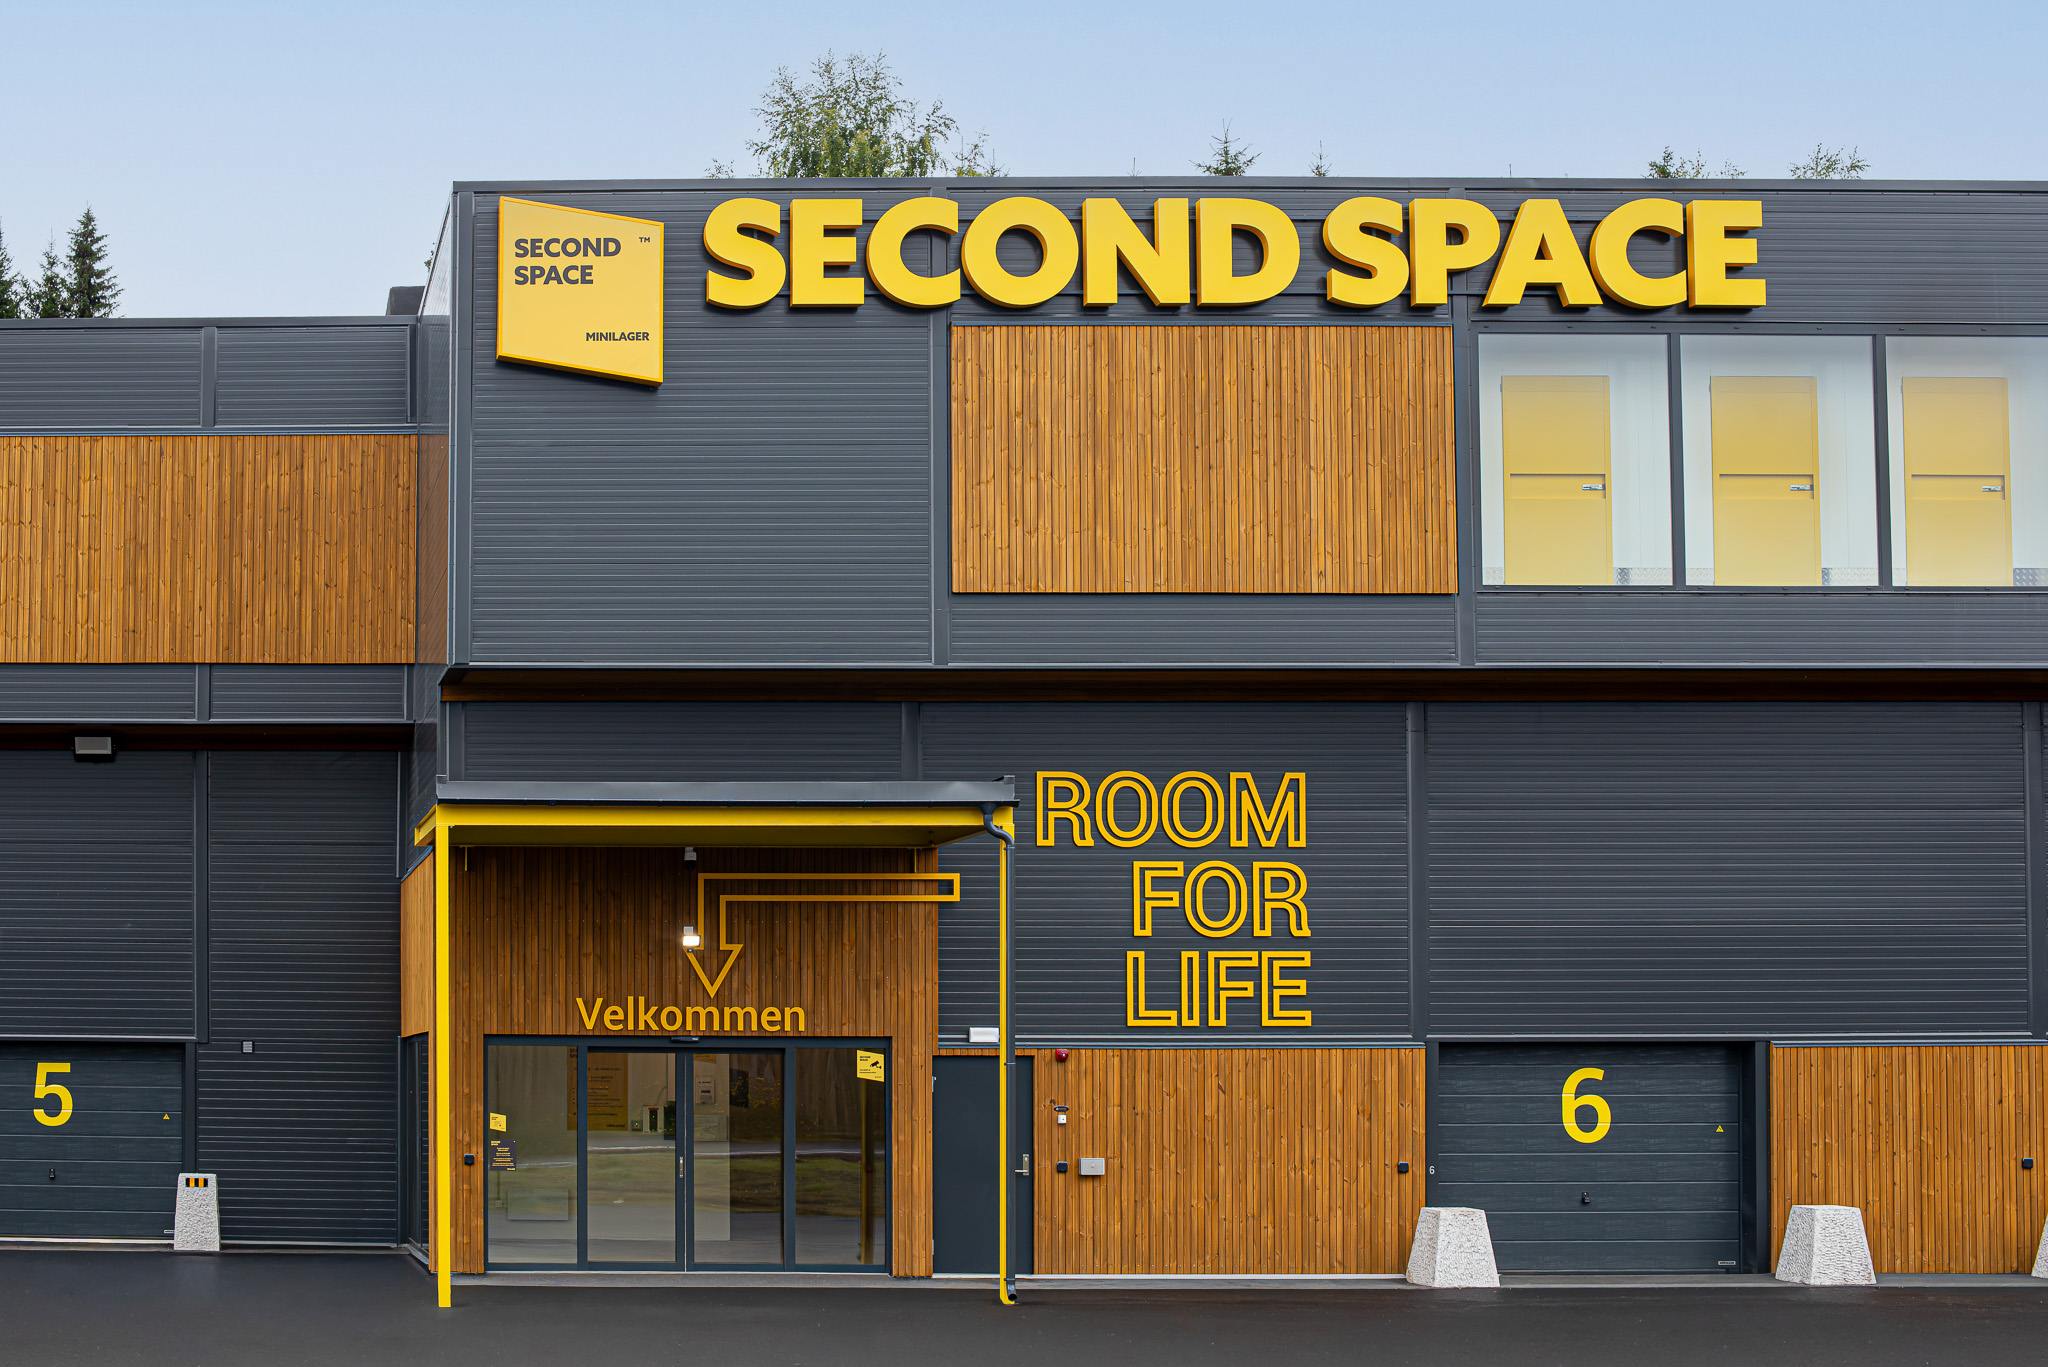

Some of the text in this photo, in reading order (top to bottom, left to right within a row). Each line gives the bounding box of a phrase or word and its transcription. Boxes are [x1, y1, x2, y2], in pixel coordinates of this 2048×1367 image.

[514, 237, 621, 258] SECOND
[514, 265, 594, 285] SPACE
[703, 196, 1767, 309] SECOND SPACE
[585, 331, 650, 342] MINILAGER
[1036, 770, 1307, 848] ROOM
[1132, 860, 1311, 938] FOR
[575, 996, 806, 1032] Velkommen
[1126, 951, 1312, 1027] LIFE
[33, 1062, 73, 1126] 5
[1561, 1067, 1612, 1144] 6
[1429, 1165, 1435, 1175] 6
